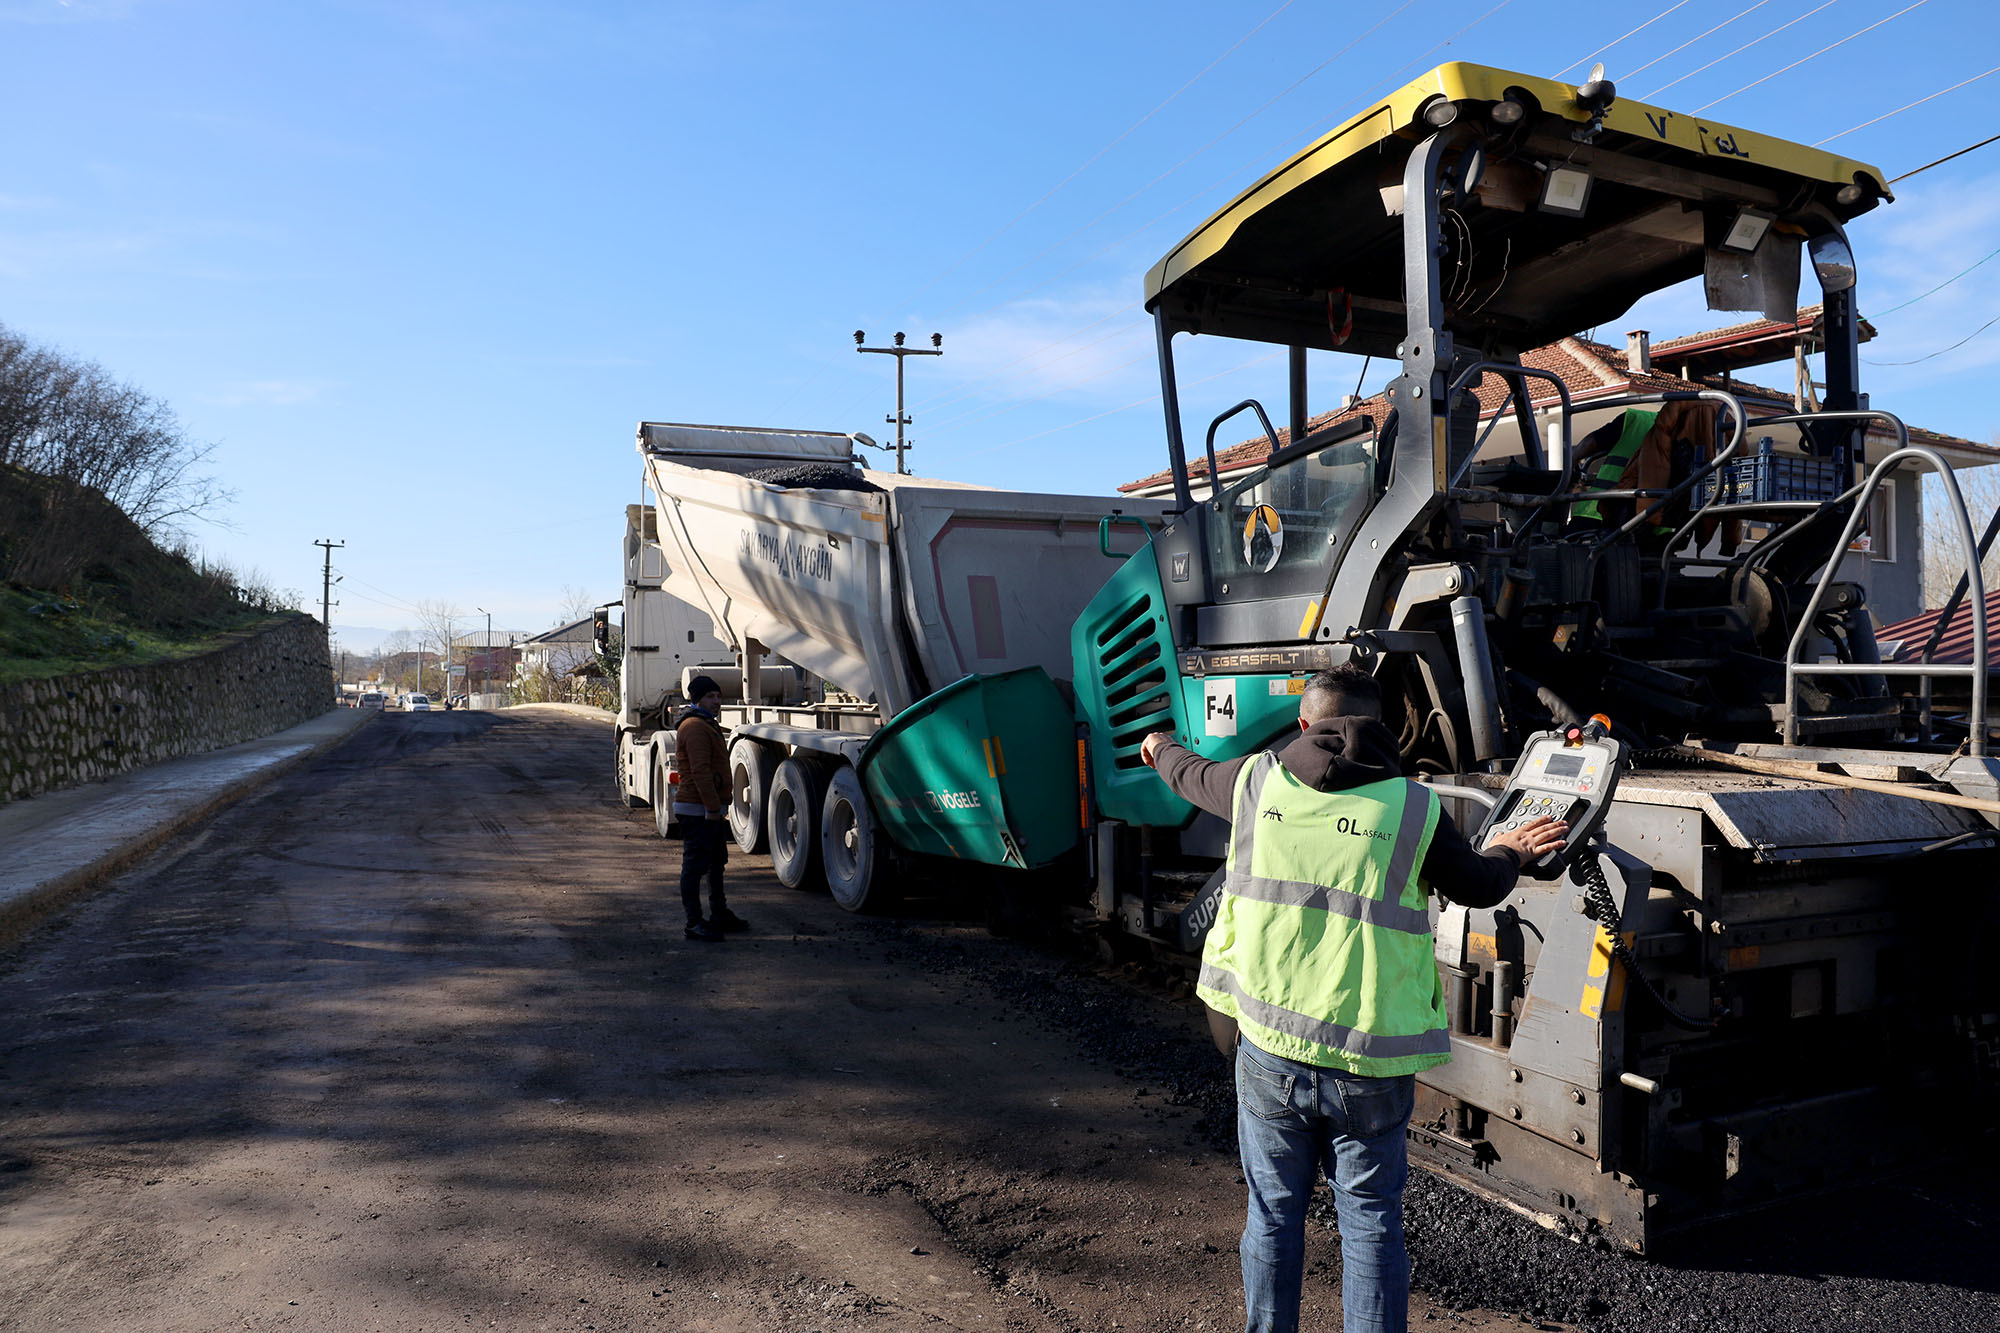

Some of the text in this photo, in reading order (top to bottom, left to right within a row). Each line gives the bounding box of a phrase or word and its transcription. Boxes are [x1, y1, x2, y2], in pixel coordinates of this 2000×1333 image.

[740, 528, 833, 582] SAKARYA AYGÜN
[1174, 559, 1186, 575] W
[1211, 652, 1300, 668] EGEASFALT
[1206, 694, 1234, 720] F-4
[938, 789, 981, 809] VÖGELE
[1187, 880, 1227, 938] SUPE
